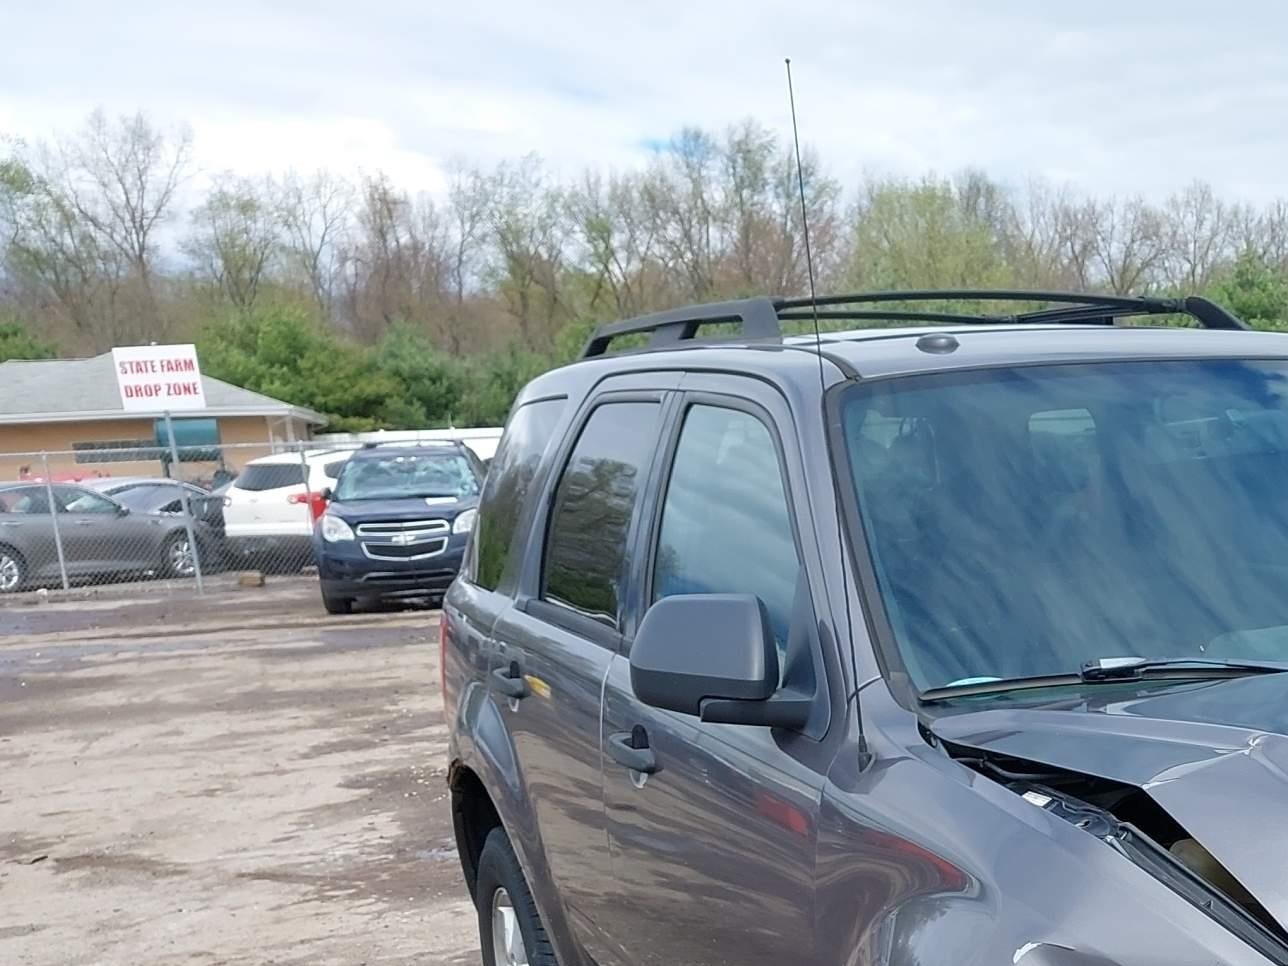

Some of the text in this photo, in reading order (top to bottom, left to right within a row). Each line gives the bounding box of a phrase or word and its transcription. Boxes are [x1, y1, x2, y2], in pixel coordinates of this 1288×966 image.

[119, 358, 195, 375] STATE FARM
[124, 382, 200, 398] DROP ZONE
